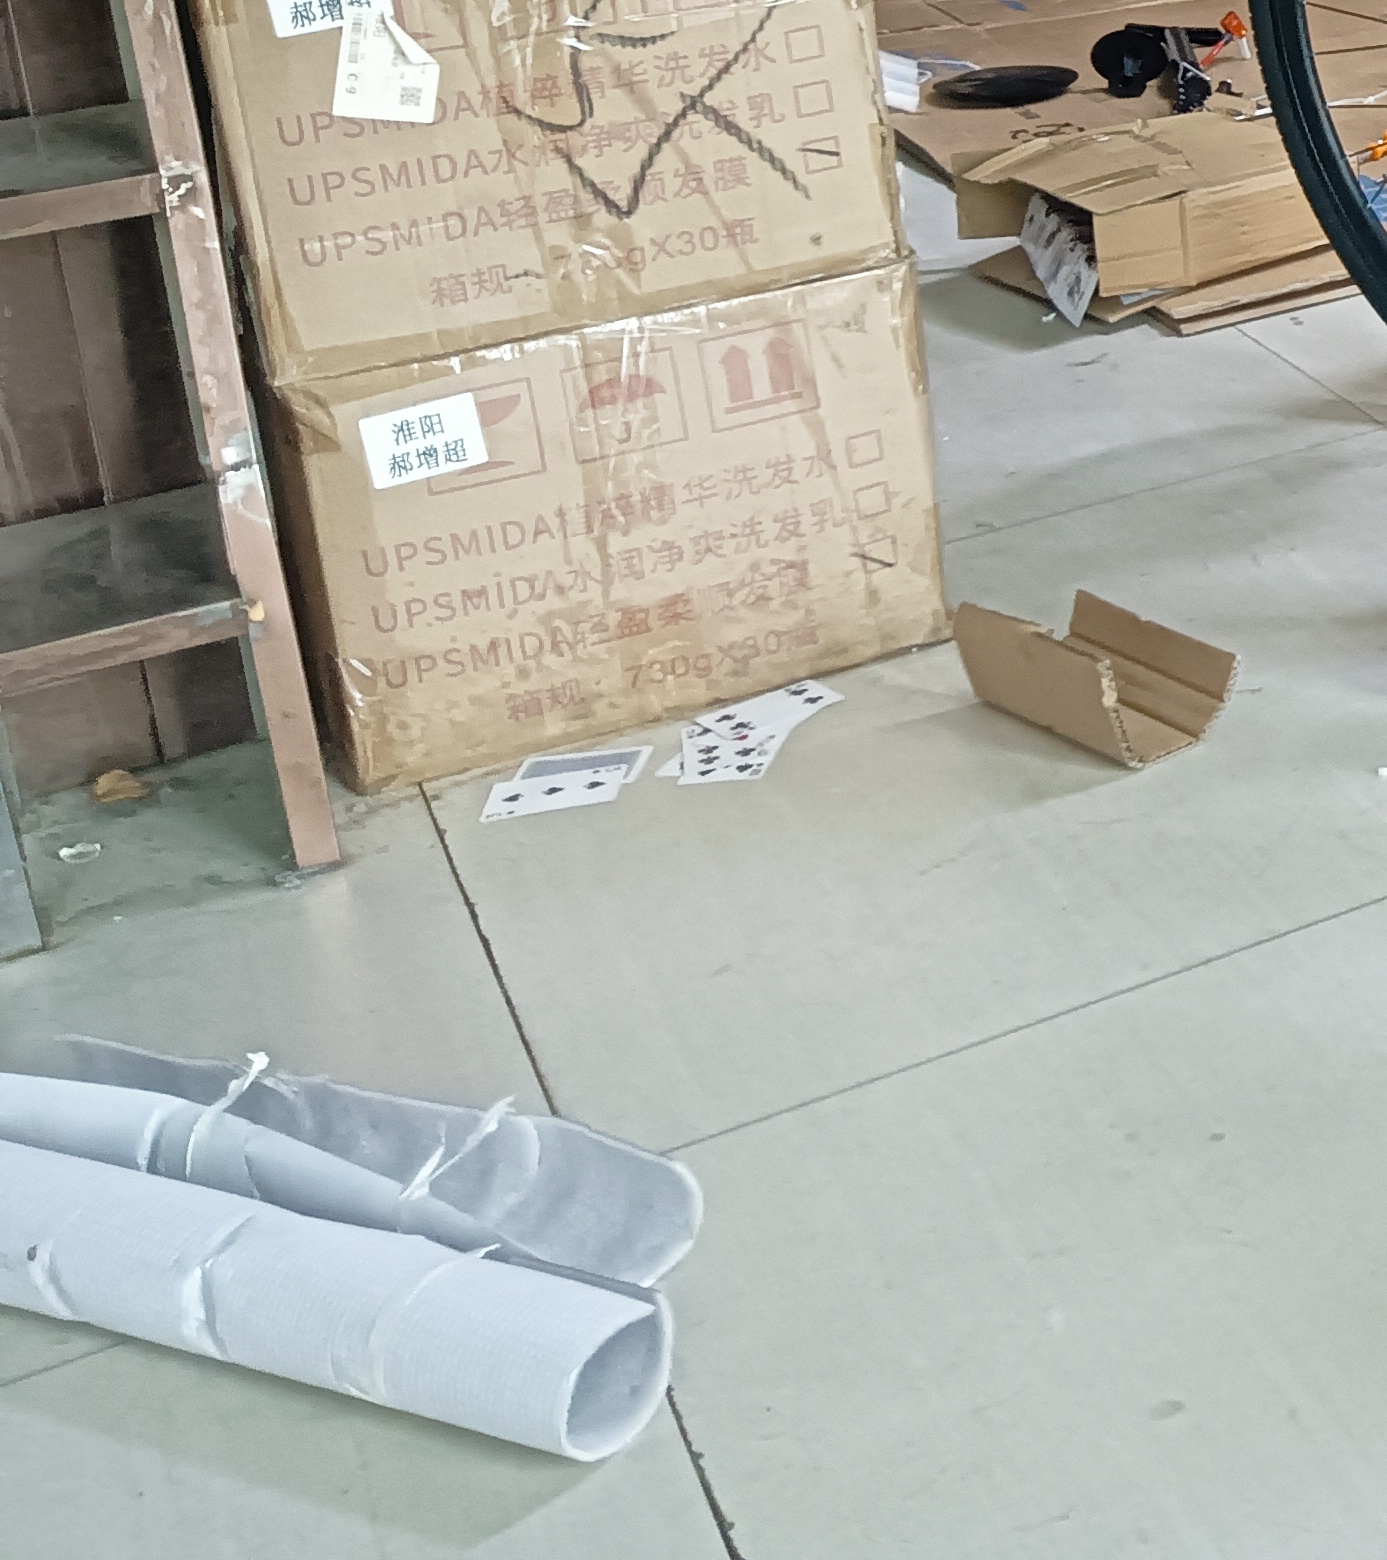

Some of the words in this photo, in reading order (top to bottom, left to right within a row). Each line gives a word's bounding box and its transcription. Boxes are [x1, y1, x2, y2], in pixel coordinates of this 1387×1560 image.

[391, 411, 445, 446] 淮阳
[387, 440, 468, 480] 郝增超
